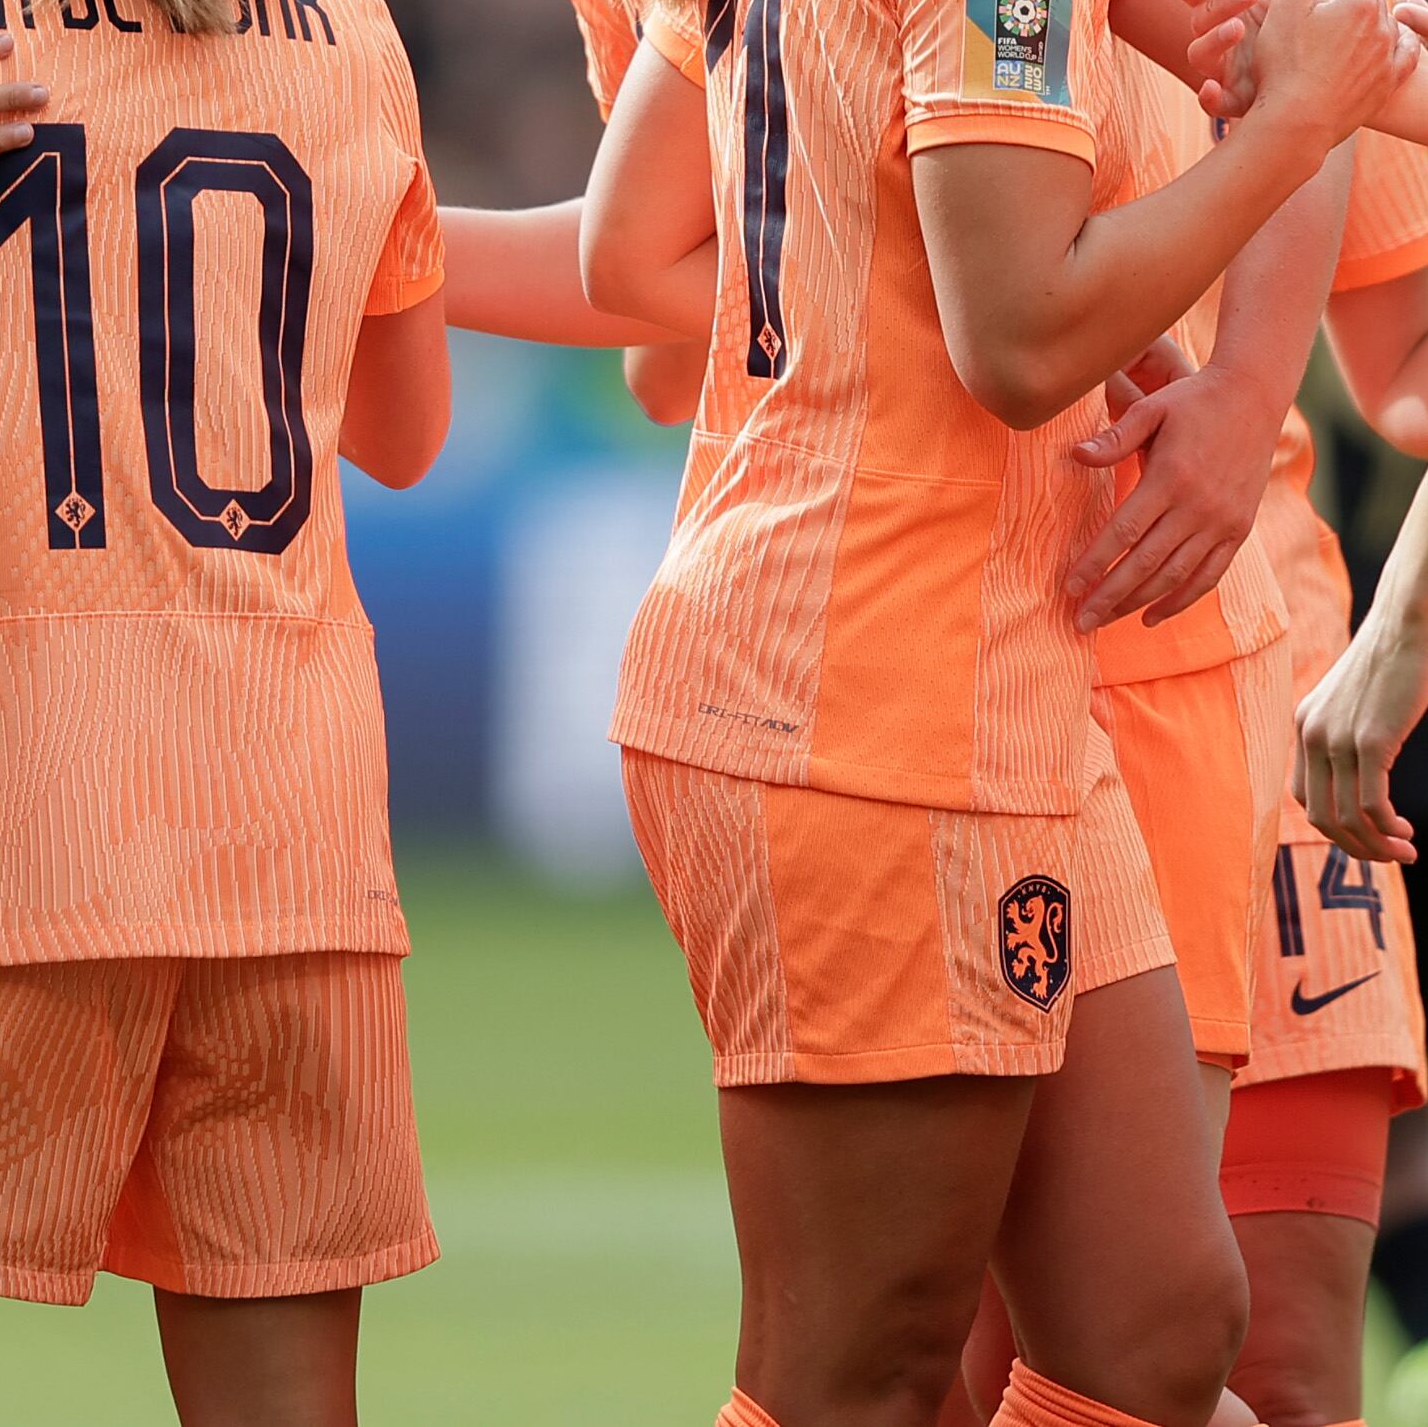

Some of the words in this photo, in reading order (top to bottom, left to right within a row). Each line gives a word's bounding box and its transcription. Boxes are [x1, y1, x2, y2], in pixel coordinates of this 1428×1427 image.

[998, 37, 1017, 45] FIFA
[997, 45, 1032, 54] WOMEN'S
[997, 63, 1021, 75] AU
[997, 75, 1021, 87] NZ
[1272, 843, 1386, 958] 14
